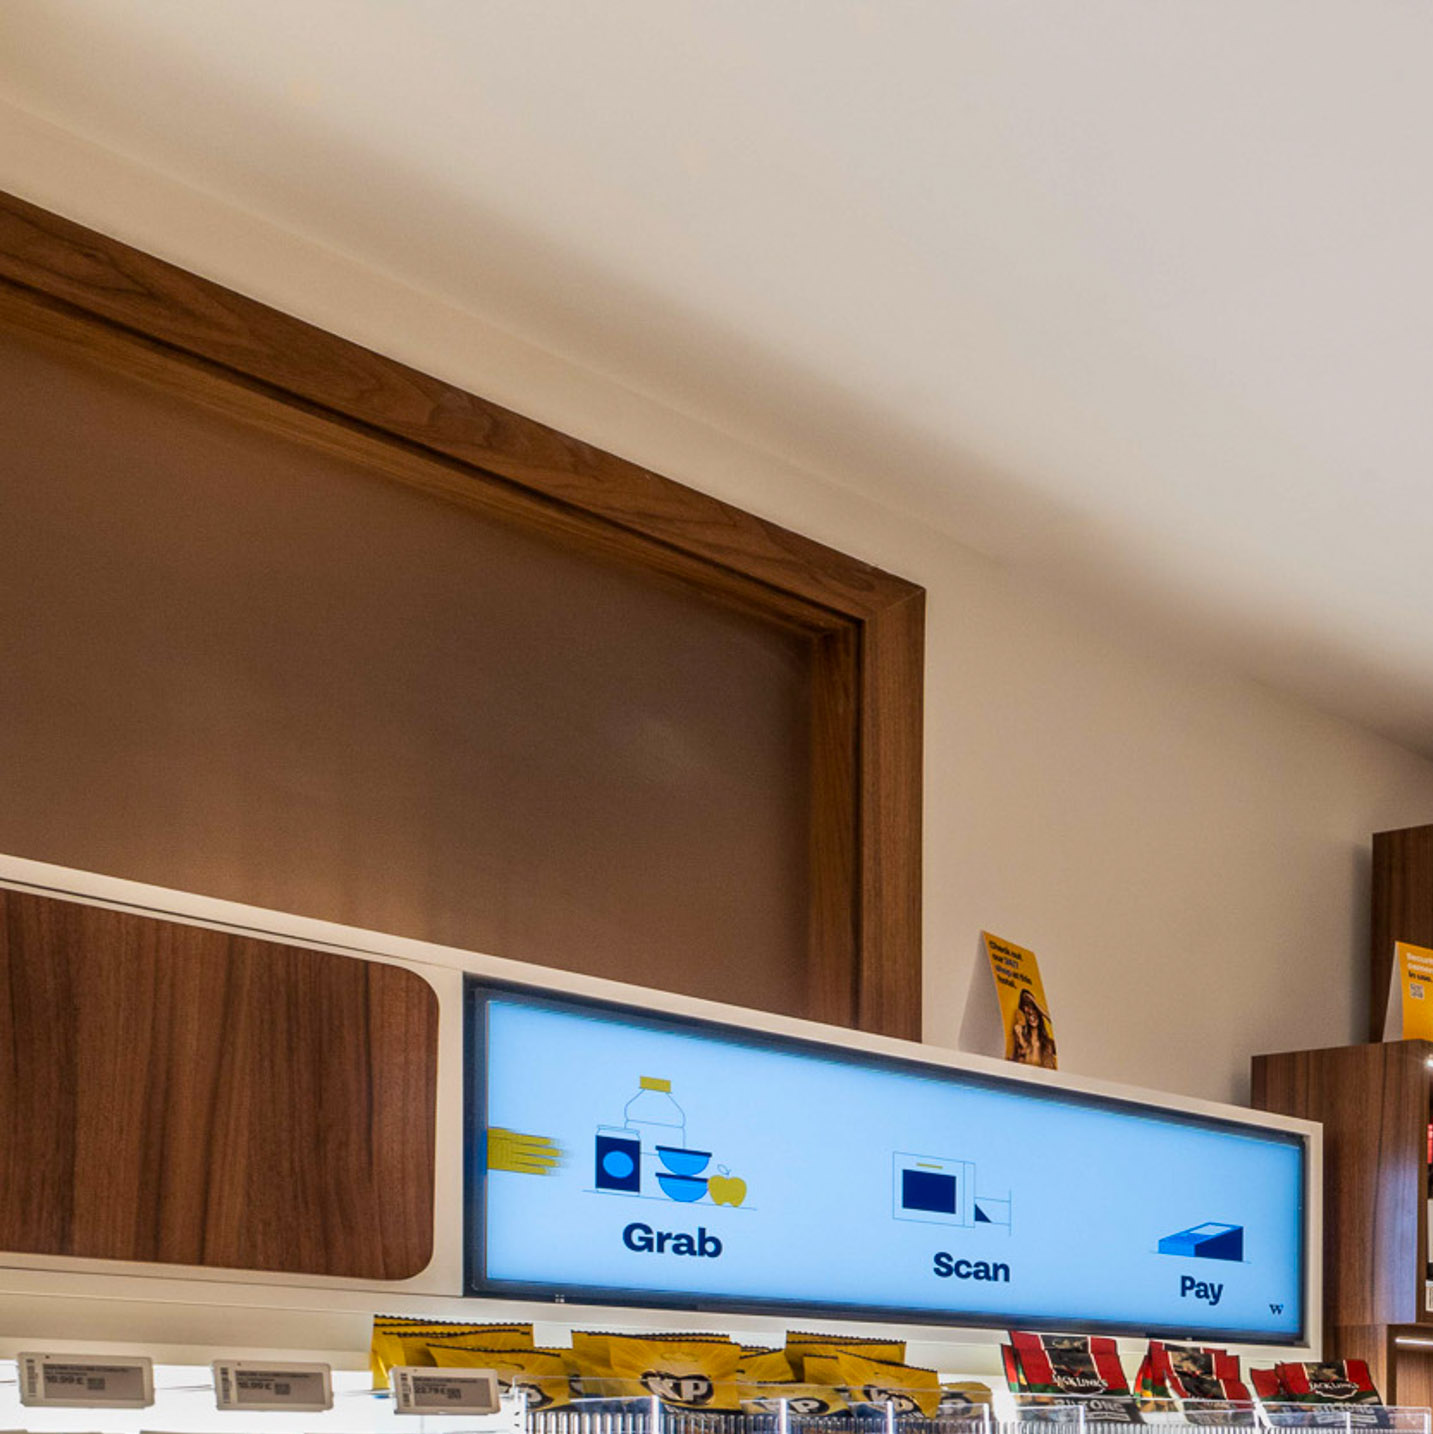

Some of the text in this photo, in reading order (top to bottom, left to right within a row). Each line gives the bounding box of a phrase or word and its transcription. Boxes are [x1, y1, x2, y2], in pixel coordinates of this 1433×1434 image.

[622, 1223, 722, 1259] Grab
[932, 1251, 1010, 1284] Scan
[1181, 1275, 1224, 1305] Pay
